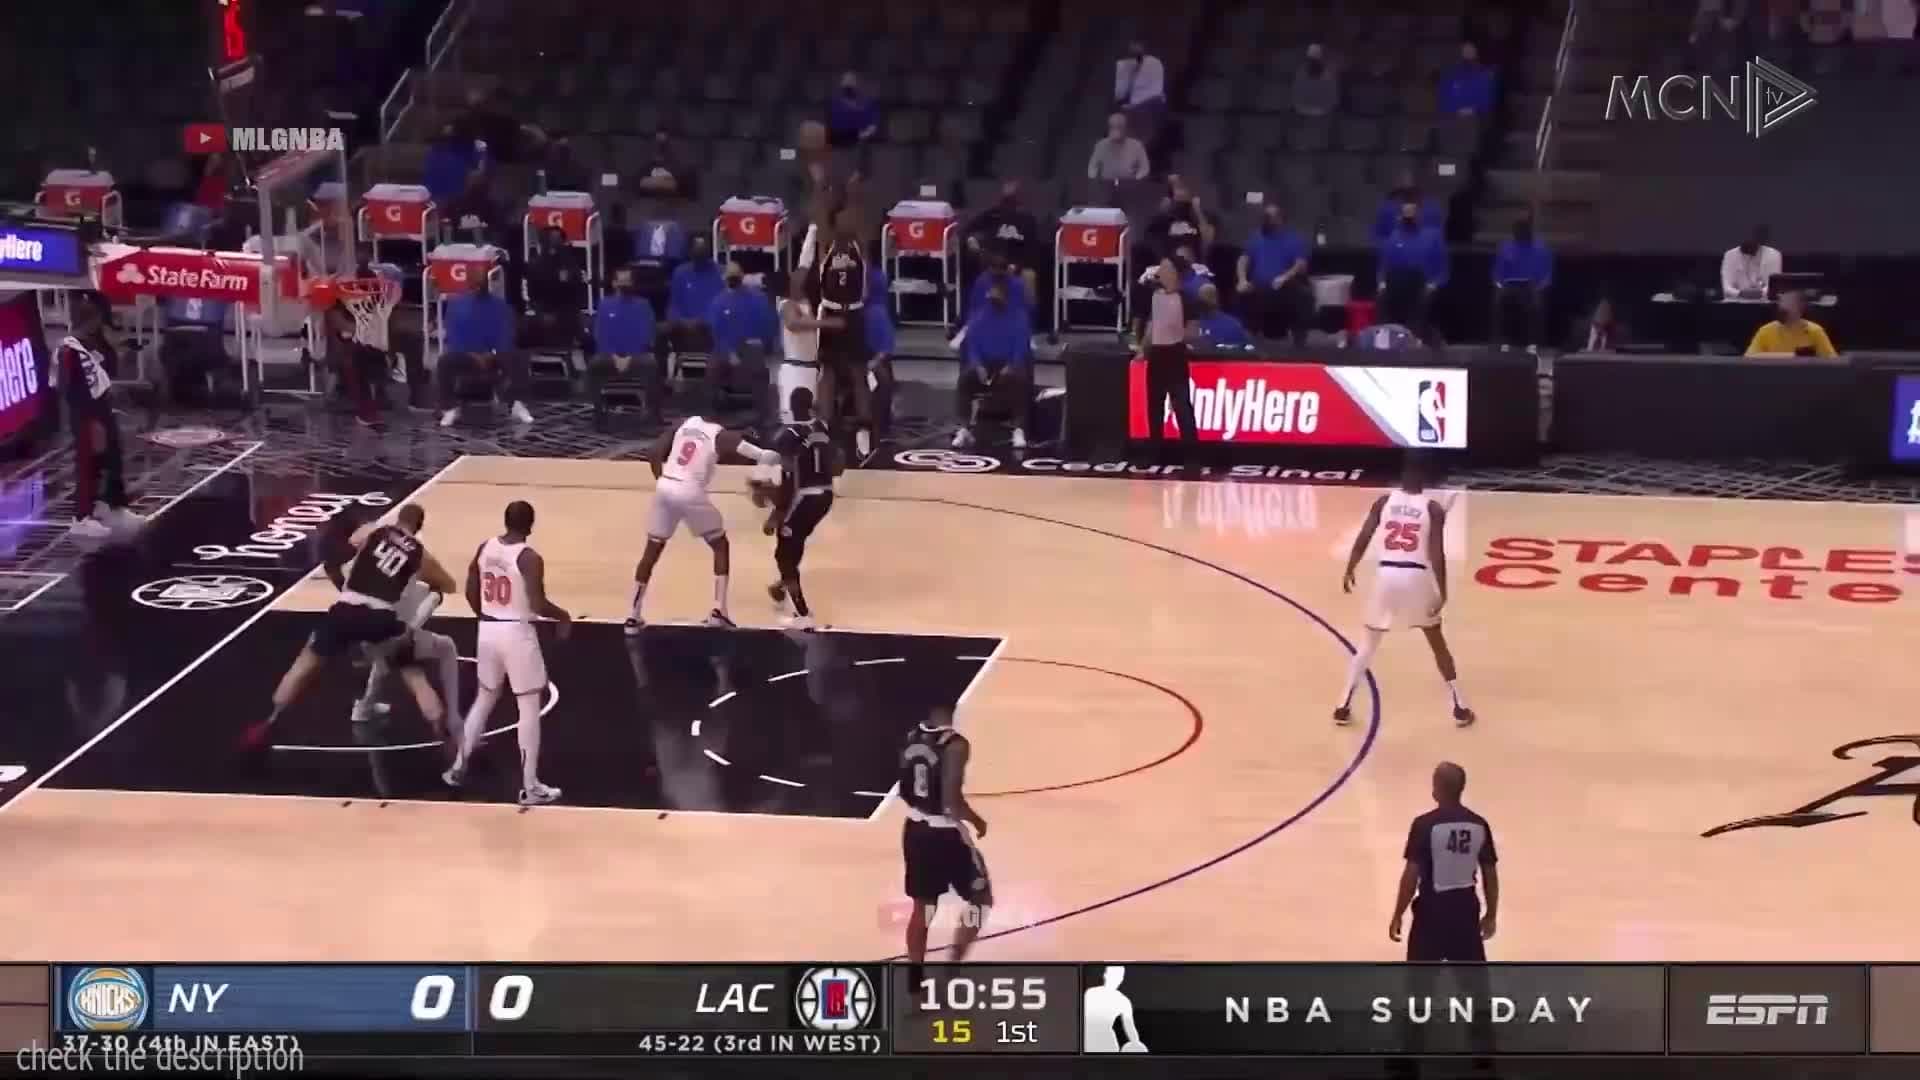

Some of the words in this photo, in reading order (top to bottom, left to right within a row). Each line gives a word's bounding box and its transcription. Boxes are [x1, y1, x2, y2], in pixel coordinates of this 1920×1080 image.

[739, 218, 756, 235] G
[908, 222, 925, 239] G
[1081, 229, 1098, 246] G
[450, 264, 467, 281] G
[678, 441, 697, 467] 9
[193, 490, 393, 561] honey
[1383, 520, 1422, 553] 25
[483, 571, 513, 607] 30
[1446, 828, 1472, 854] 42
